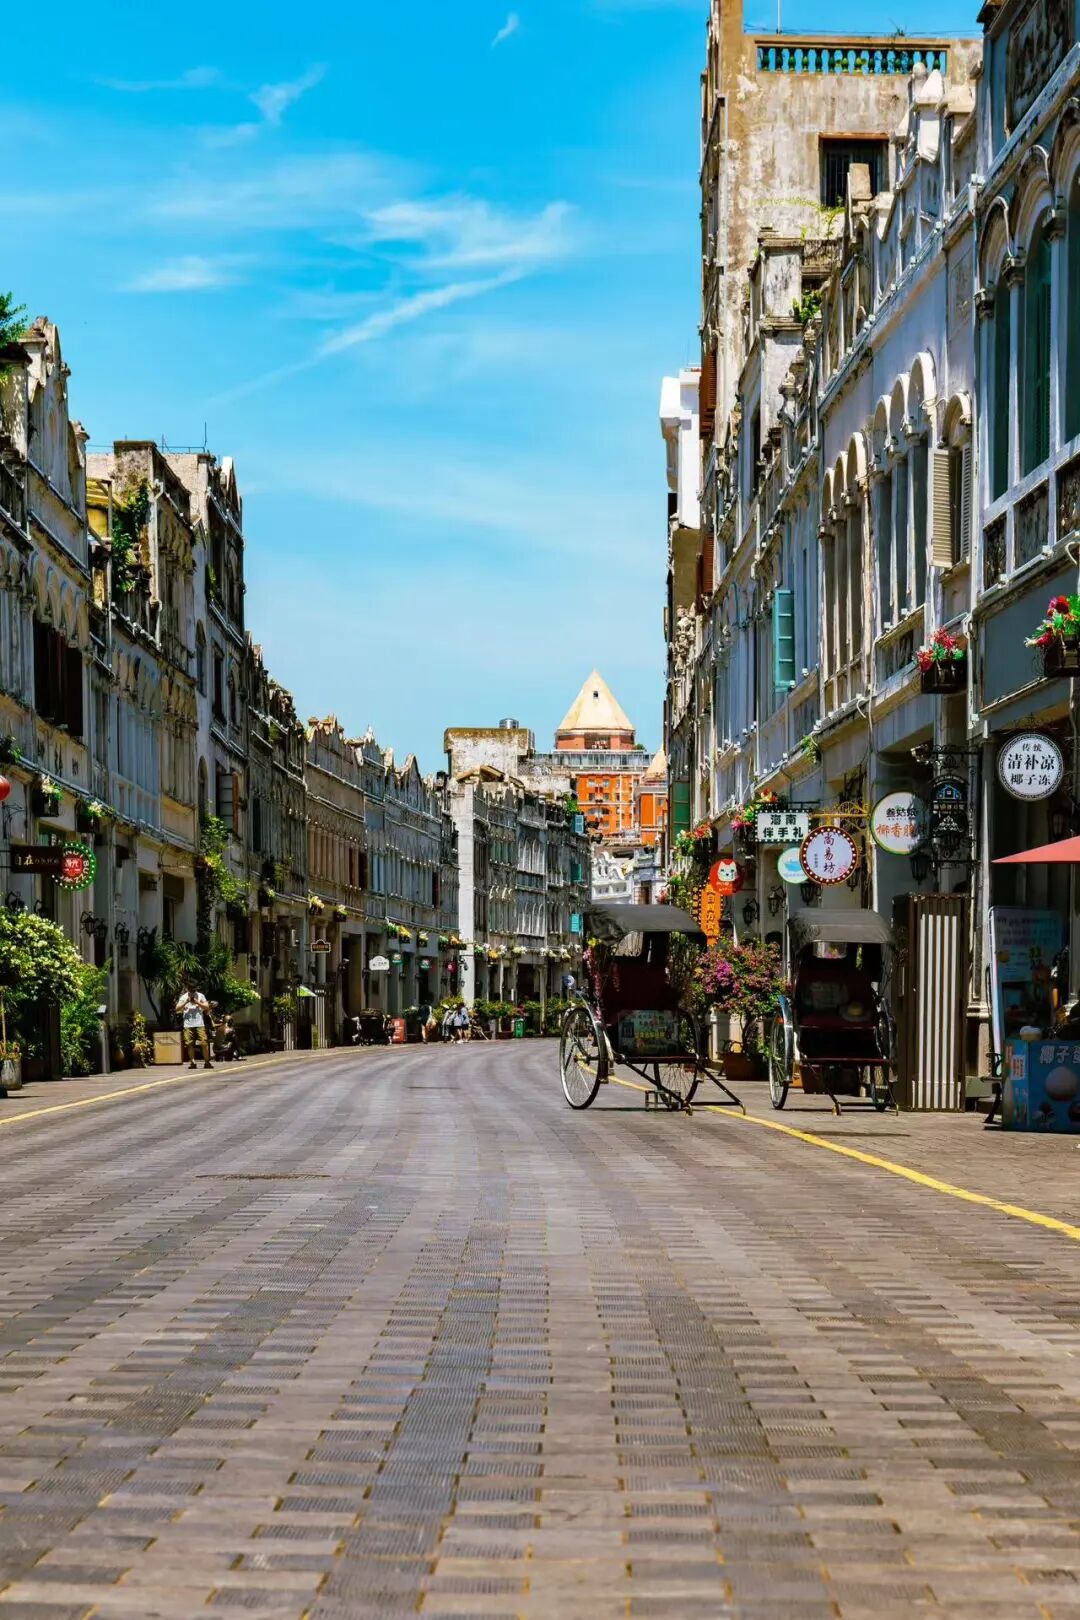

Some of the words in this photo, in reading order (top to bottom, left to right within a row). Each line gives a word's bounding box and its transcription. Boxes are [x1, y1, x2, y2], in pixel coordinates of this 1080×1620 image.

[1022, 743, 1043, 752] 传统
[1008, 753, 1055, 770] 清补凉
[1011, 773, 1051, 786] 椰子冻
[770, 814, 797, 825] 海南
[763, 827, 803, 838] 伴手礼
